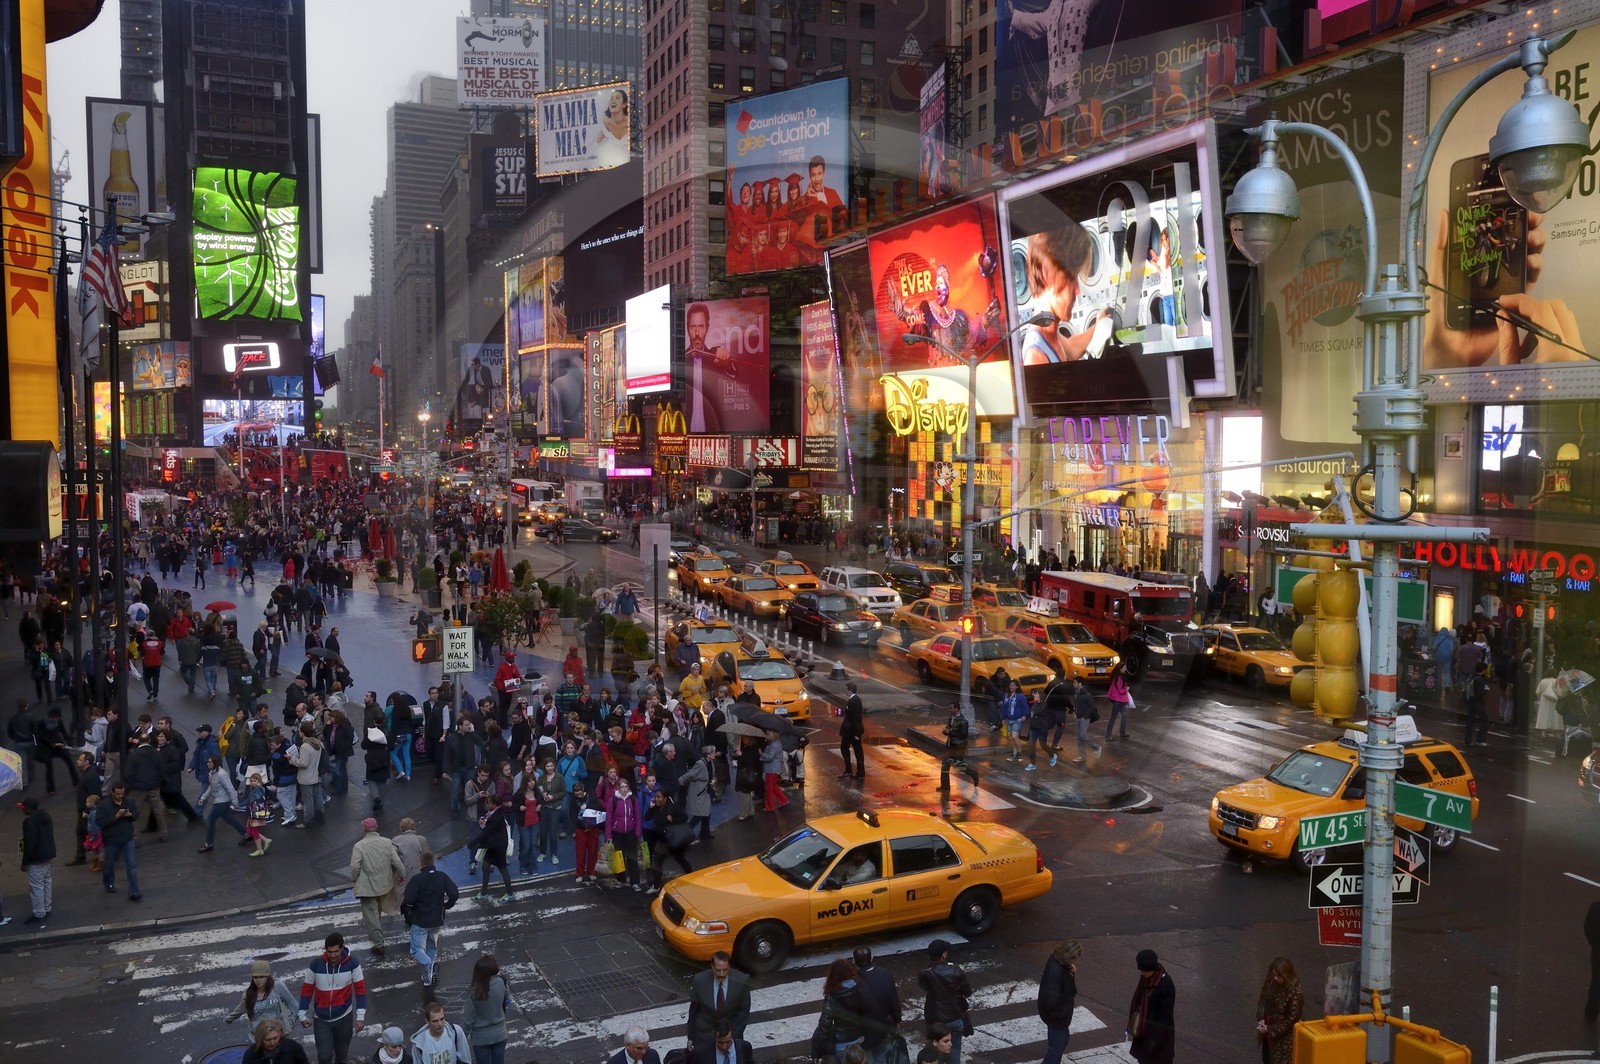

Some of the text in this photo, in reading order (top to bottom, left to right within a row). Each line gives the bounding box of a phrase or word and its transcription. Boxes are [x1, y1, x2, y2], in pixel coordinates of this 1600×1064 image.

[463, 57, 539, 67] BEST MUSICAL
[499, 67, 540, 80] BEST
[463, 79, 540, 90] MUSICAL OF
[1555, 62, 1590, 102] BE
[464, 89, 488, 98] THIS
[543, 98, 599, 132] MAMMA
[749, 106, 817, 131] Countdown to
[554, 127, 587, 159] MIA!
[1275, 109, 1393, 171] AMOUS
[495, 147, 517, 157] JESUS
[495, 156, 526, 174] SUP
[495, 173, 527, 195] STA
[194, 232, 257, 243] display powered
[1550, 226, 1591, 241] Samsung
[197, 241, 256, 253] by wind energy
[1462, 236, 1476, 251] TO
[120, 266, 155, 281] NGLOT
[901, 269, 934, 298] EVER
[1280, 256, 1346, 322] PLANET
[905, 312, 926, 326] COME
[1299, 337, 1364, 353] TIMES SQUAR
[592, 339, 600, 418] PALACE
[1048, 415, 1173, 468] FOREVER
[1273, 456, 1347, 475] restaurant
[1238, 524, 1290, 543] SROVSKI
[1415, 540, 1600, 581] HOLLYWOO
[1510, 571, 1525, 584] BAR
[1574, 579, 1591, 592] BAR
[448, 631, 468, 640] WAIT
[450, 641, 466, 650] FOR
[447, 651, 470, 660] WALK
[446, 661, 471, 670] SIGNAL
[1423, 792, 1438, 818] 7
[1301, 814, 1363, 846] W 45 St
[1398, 838, 1420, 865] WAY
[1331, 876, 1364, 894] ONE
[817, 897, 874, 919] NYC TAXI
[1322, 907, 1362, 917] NO STAN
[1330, 918, 1361, 929] ANYTI
